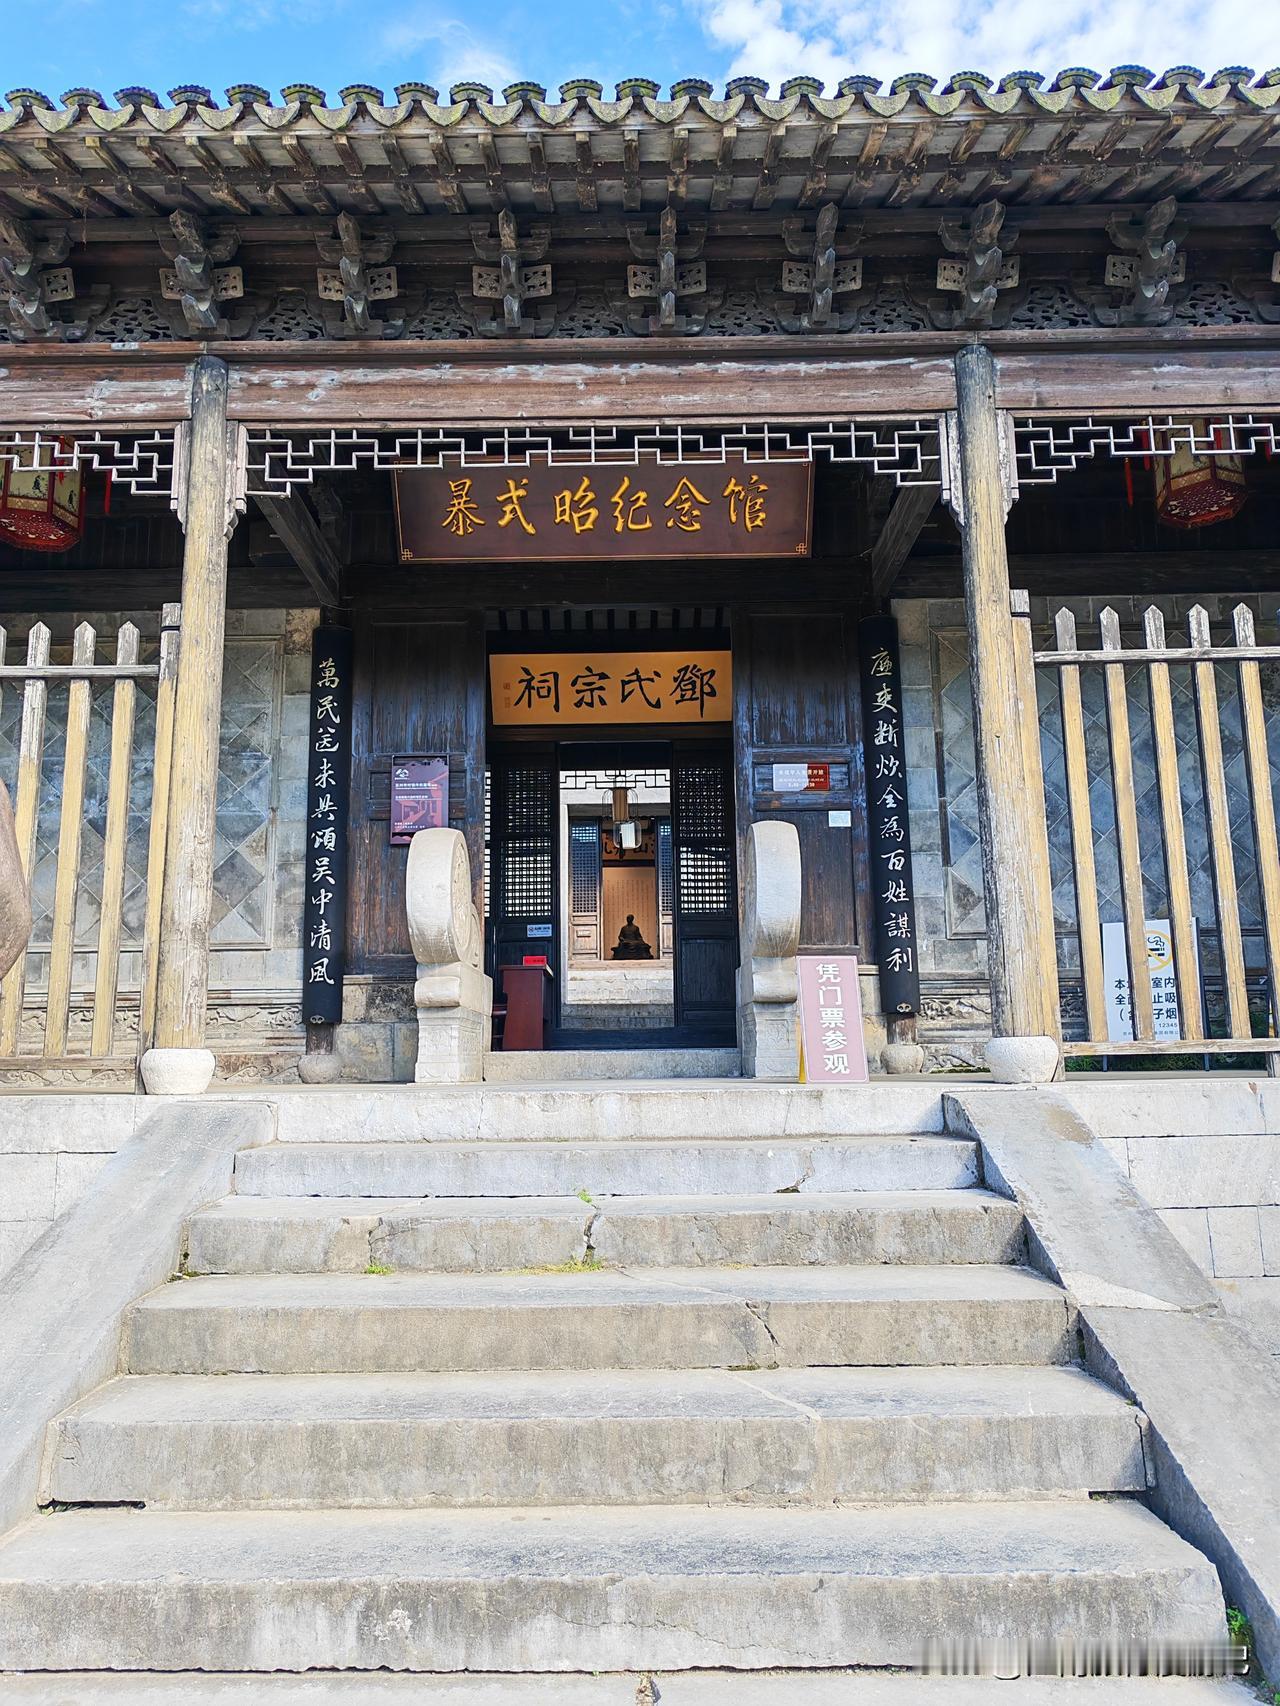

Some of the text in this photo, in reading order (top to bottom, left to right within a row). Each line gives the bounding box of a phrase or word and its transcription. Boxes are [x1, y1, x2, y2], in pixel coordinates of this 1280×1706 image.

[442, 474, 769, 537] 暴式昭纪念馆
[513, 663, 717, 718] 鄧氏宗祠
[815, 963, 851, 1075] 凭门票参观
